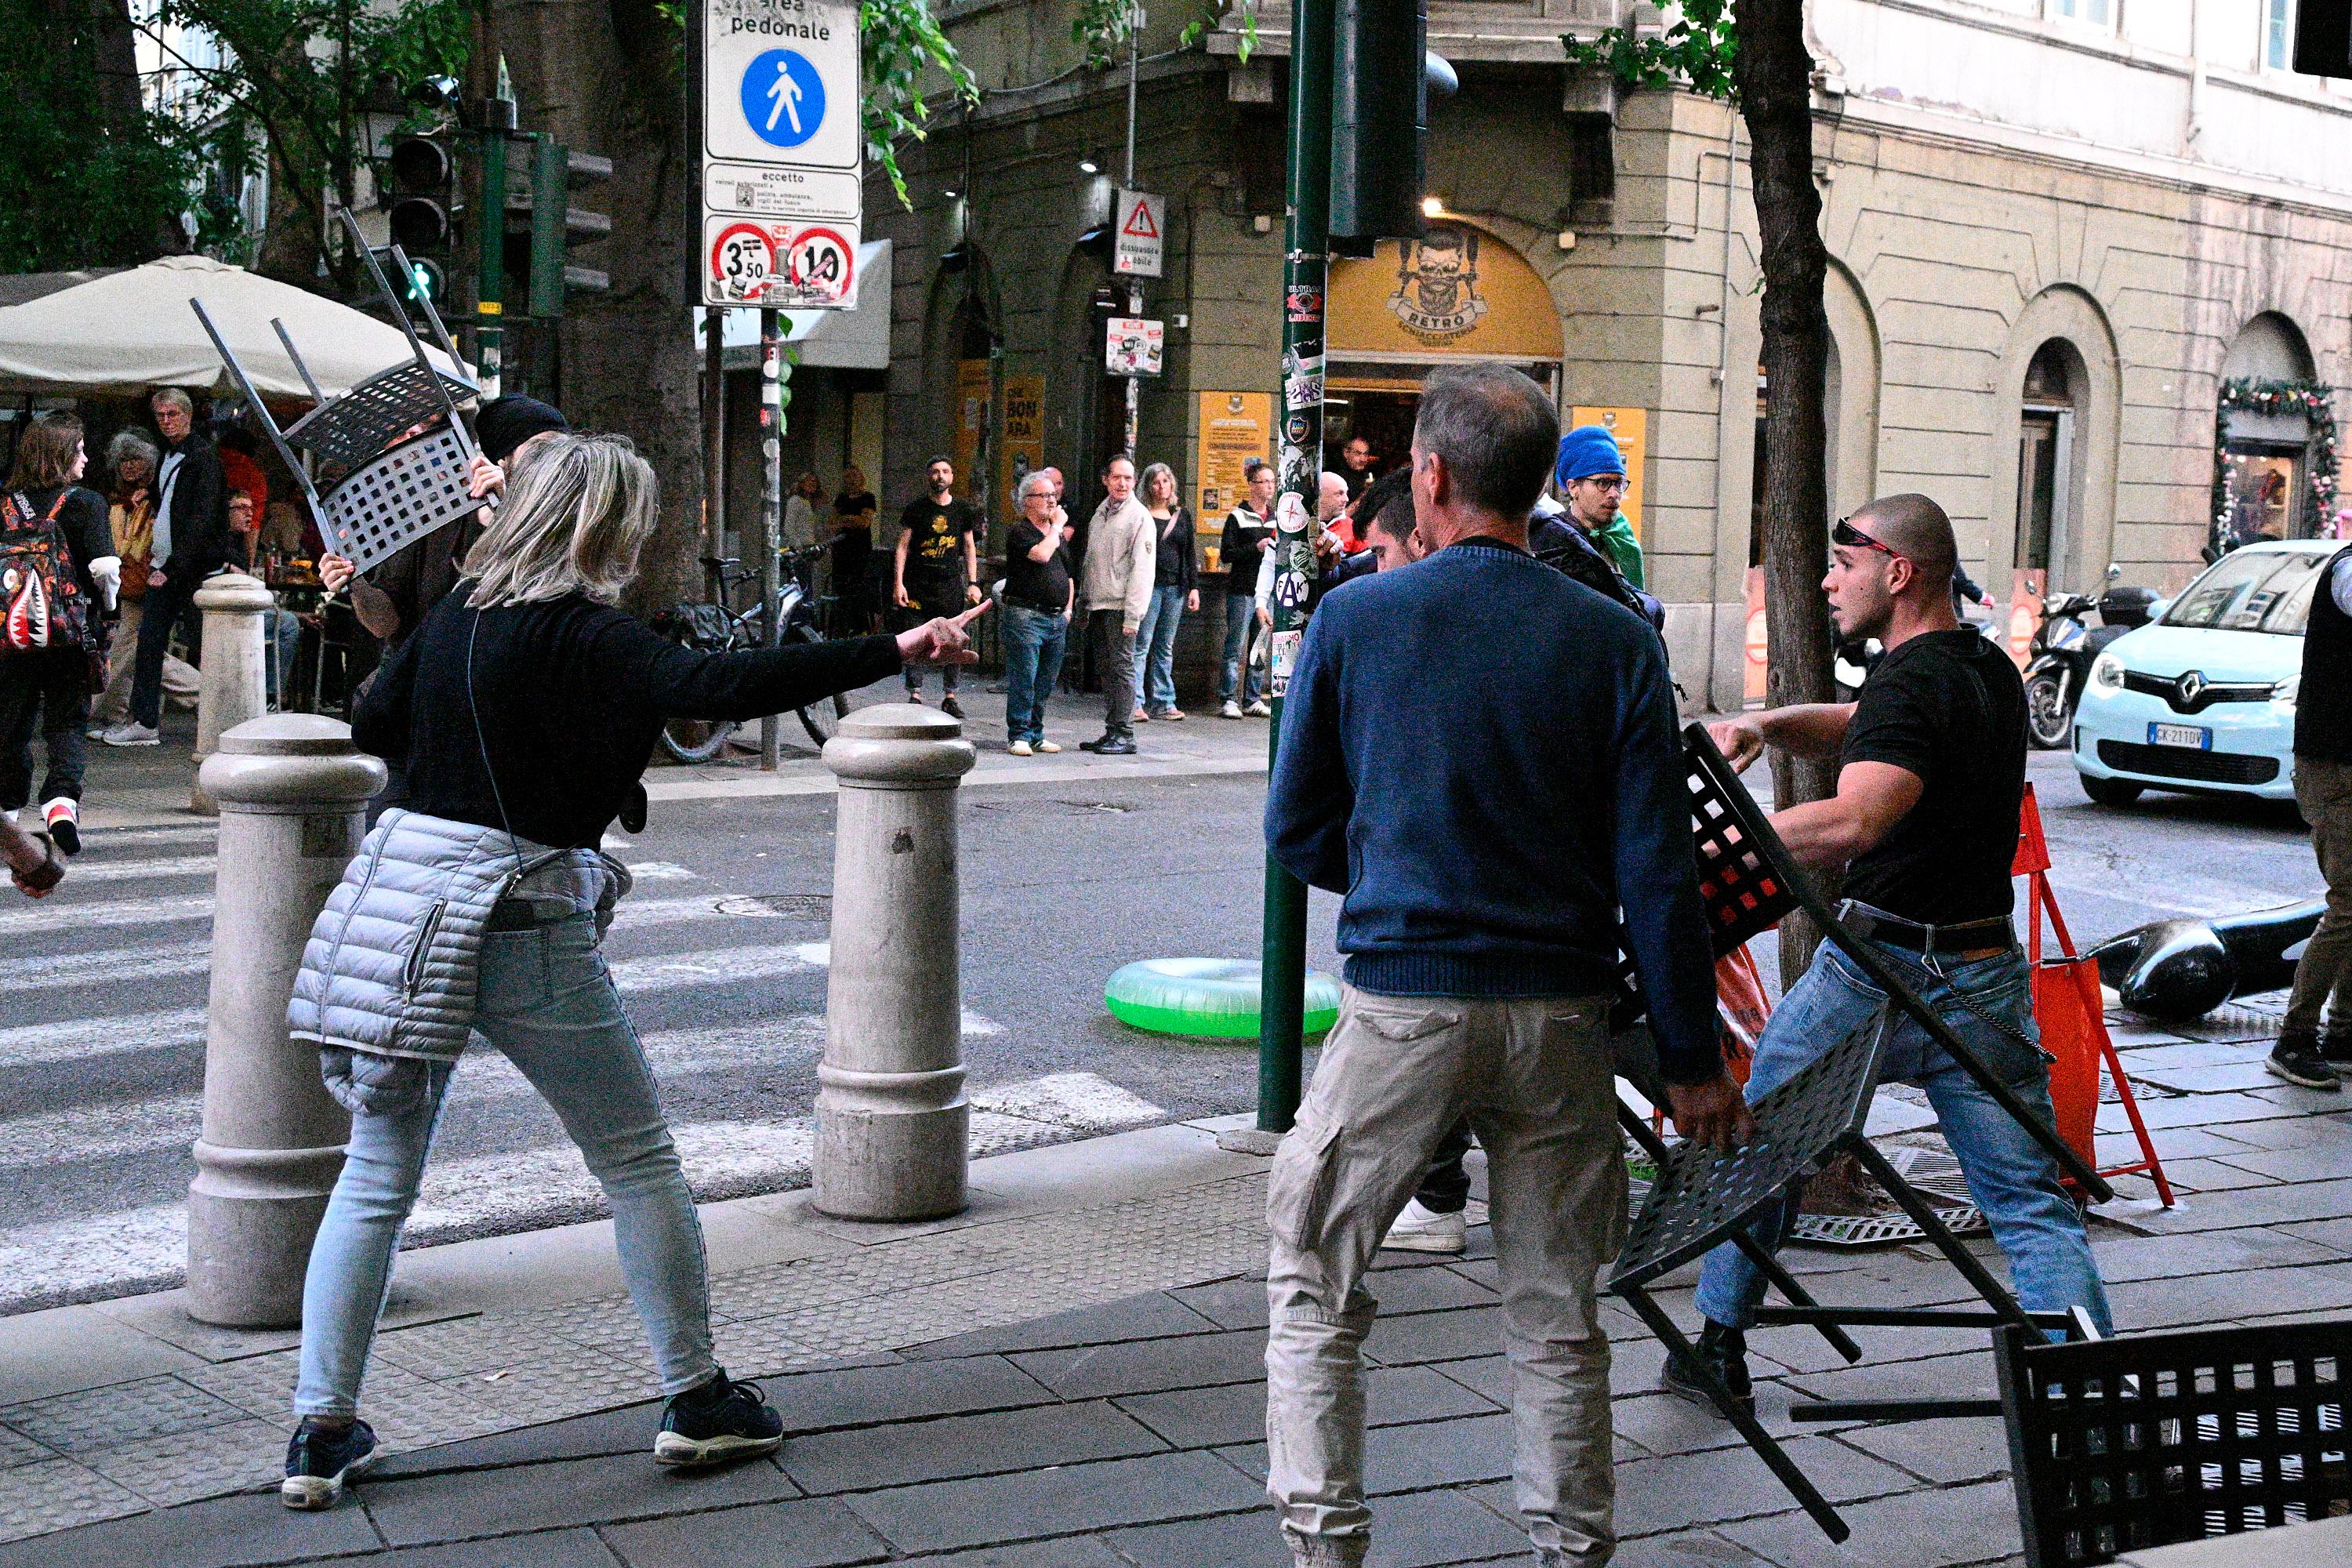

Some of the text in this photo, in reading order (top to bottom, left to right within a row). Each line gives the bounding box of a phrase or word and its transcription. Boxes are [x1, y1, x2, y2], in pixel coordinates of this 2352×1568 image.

[731, 16, 829, 40] pedonale
[762, 172, 804, 183] eccetto
[746, 263, 764, 278] 50
[1288, 285, 1322, 293] ULTRAS
